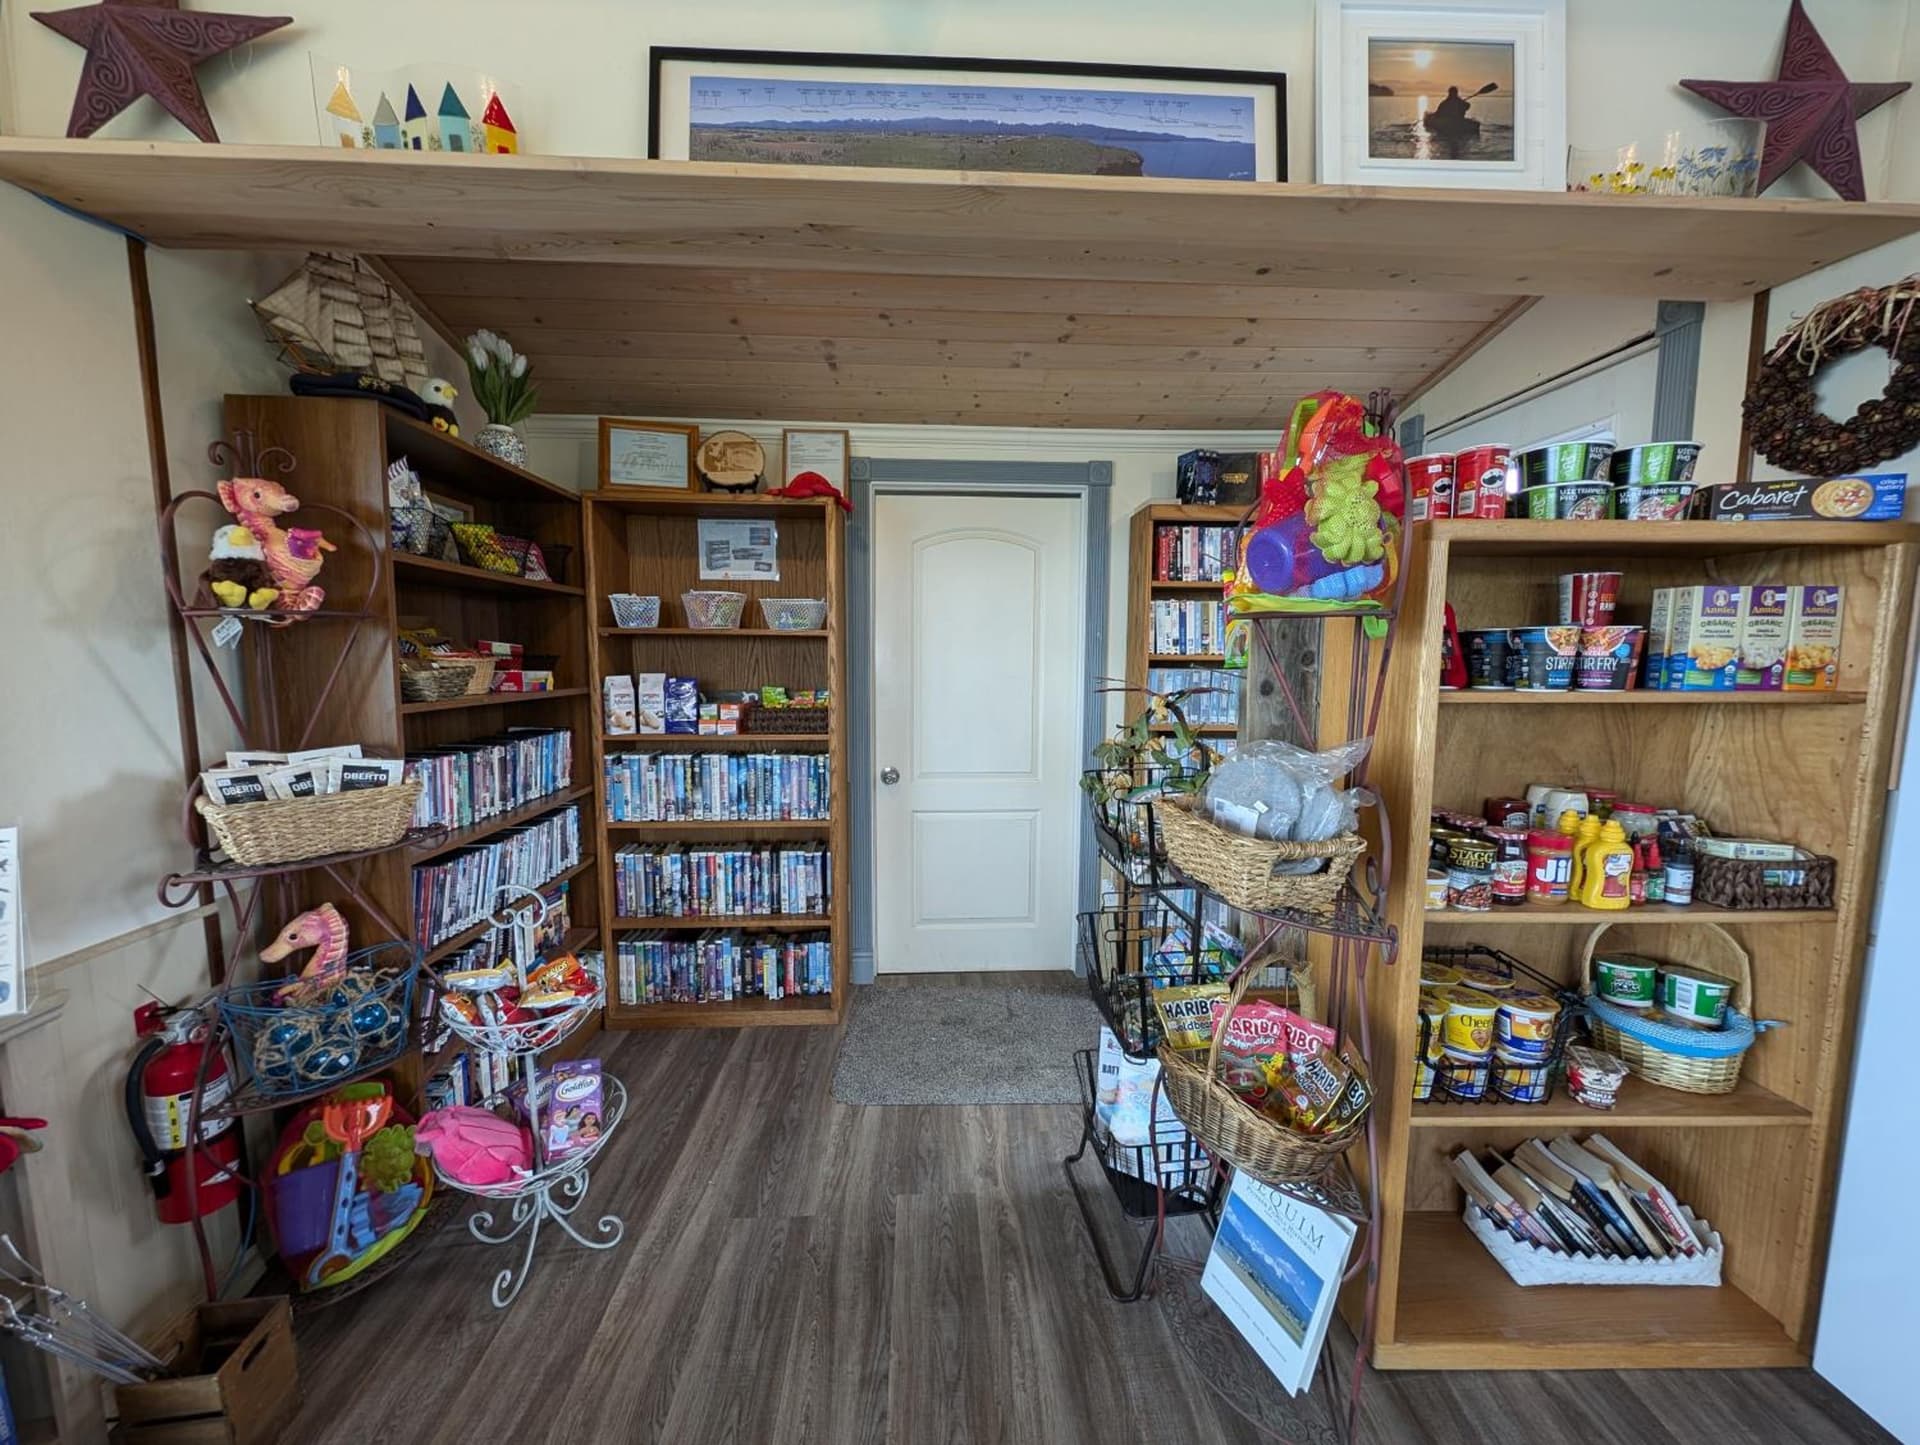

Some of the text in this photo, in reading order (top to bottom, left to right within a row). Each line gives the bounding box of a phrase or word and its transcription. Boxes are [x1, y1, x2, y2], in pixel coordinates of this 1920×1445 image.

[1719, 485, 1808, 510] Cabaret
[1704, 606, 1735, 615] Annie's
[1752, 606, 1783, 615] Annie's
[1806, 606, 1836, 615] Annie's
[1700, 619, 1736, 628] ORGANIC
[1748, 619, 1784, 628] ORGANIC
[1801, 619, 1836, 628] ORGANIC
[1545, 656, 1568, 671] STIR
[1597, 657, 1618, 671] FRY
[342, 772, 387, 781] OBERTO
[222, 783, 262, 796] OBERTO
[292, 781, 314, 792] OBE
[1449, 848, 1493, 864] STAGG
[1455, 860, 1485, 869] CHILI
[1535, 859, 1571, 883] Ji
[1229, 1018, 1280, 1037] ARIBO
[1285, 1022, 1323, 1054] RIBO
[1304, 1058, 1341, 1099] HARIBO
[561, 1078, 594, 1095] Goldfish
